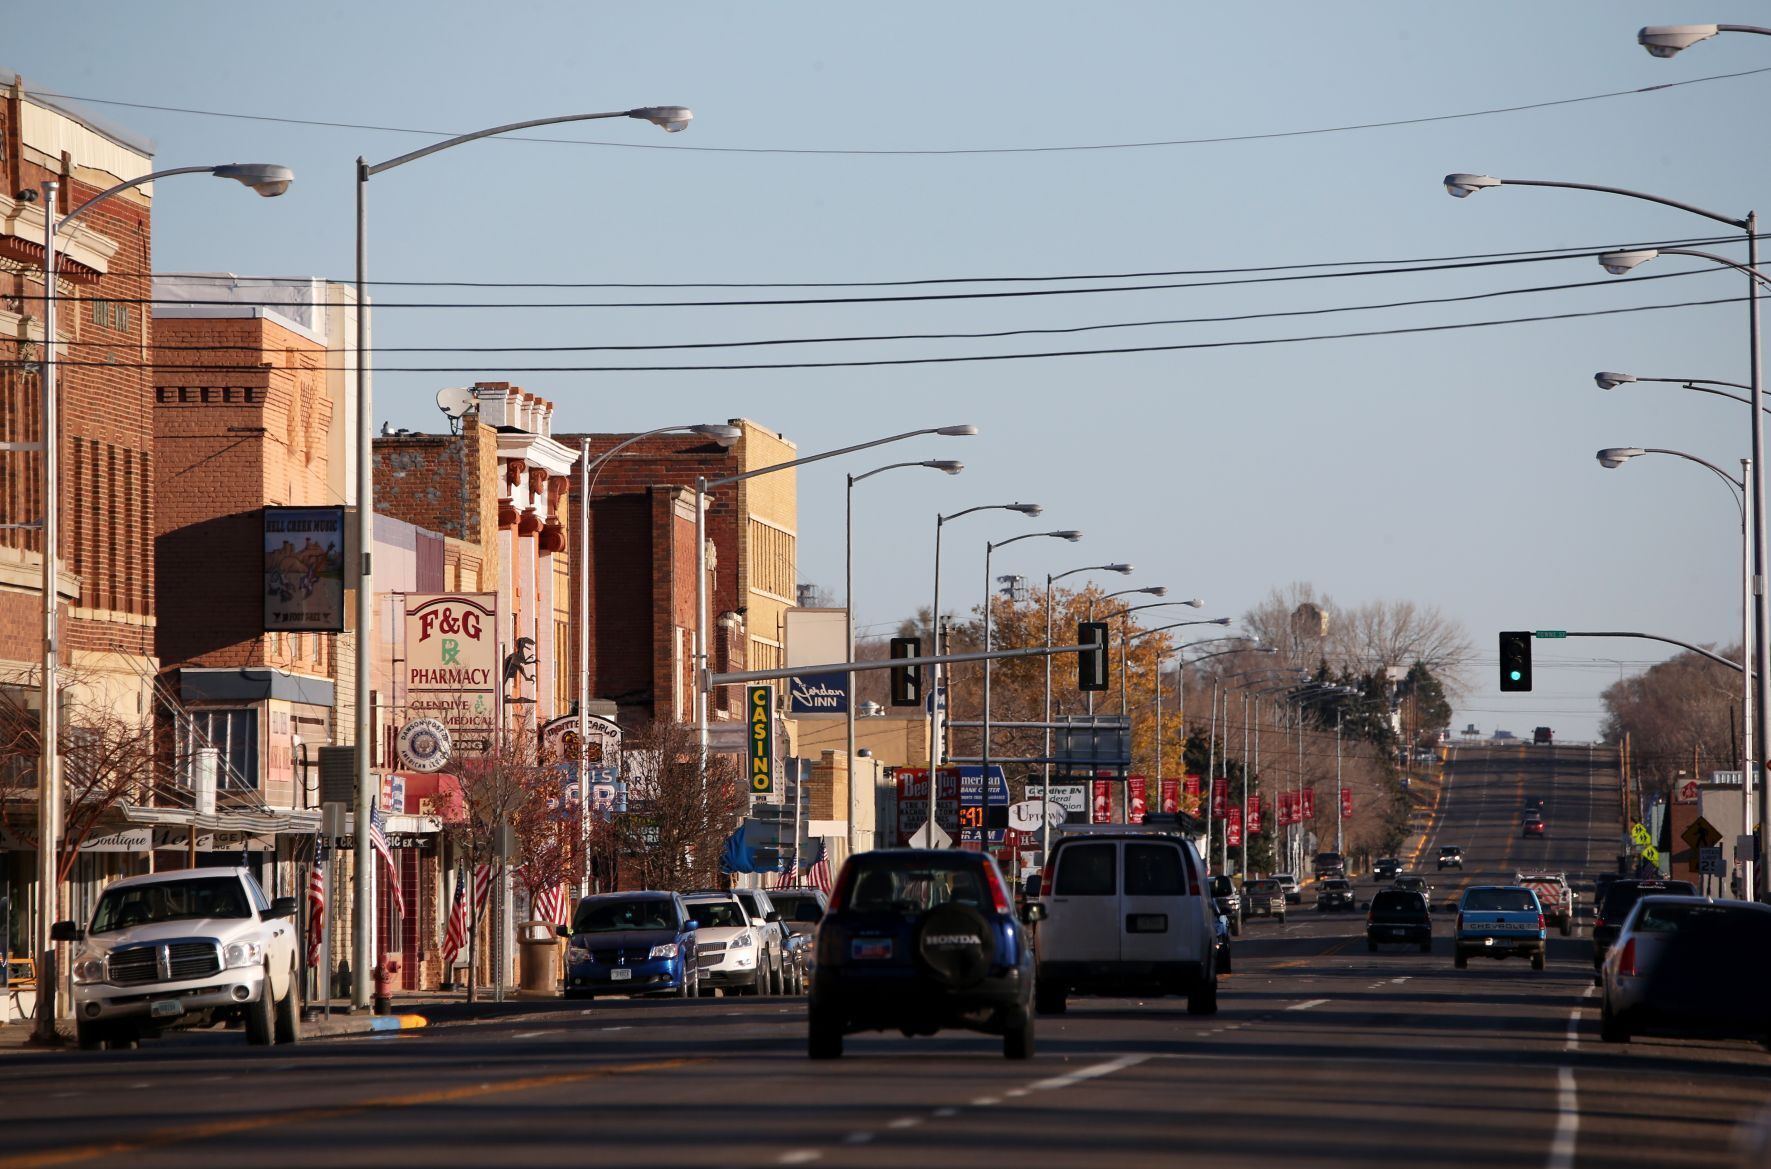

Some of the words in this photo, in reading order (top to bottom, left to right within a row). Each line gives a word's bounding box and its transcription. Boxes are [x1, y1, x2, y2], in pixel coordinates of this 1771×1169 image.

[287, 520, 312, 532] CREEK
[313, 520, 337, 532] MUSIC
[419, 607, 483, 643] F&G
[411, 668, 490, 685] PHARMACY
[793, 677, 846, 707] Jordan
[814, 697, 837, 707] INN
[445, 716, 494, 726] MEDICAL
[587, 720, 618, 738] CARLO
[401, 720, 425, 740] DAWSON
[753, 689, 769, 790] CASINO
[401, 750, 426, 769] AMERICAN
[900, 771, 931, 797] Bee
[961, 775, 1000, 785] merian
[1050, 795, 1071, 803] deral
[1016, 805, 1065, 822] UPTWN
[926, 934, 982, 944] HONDA
